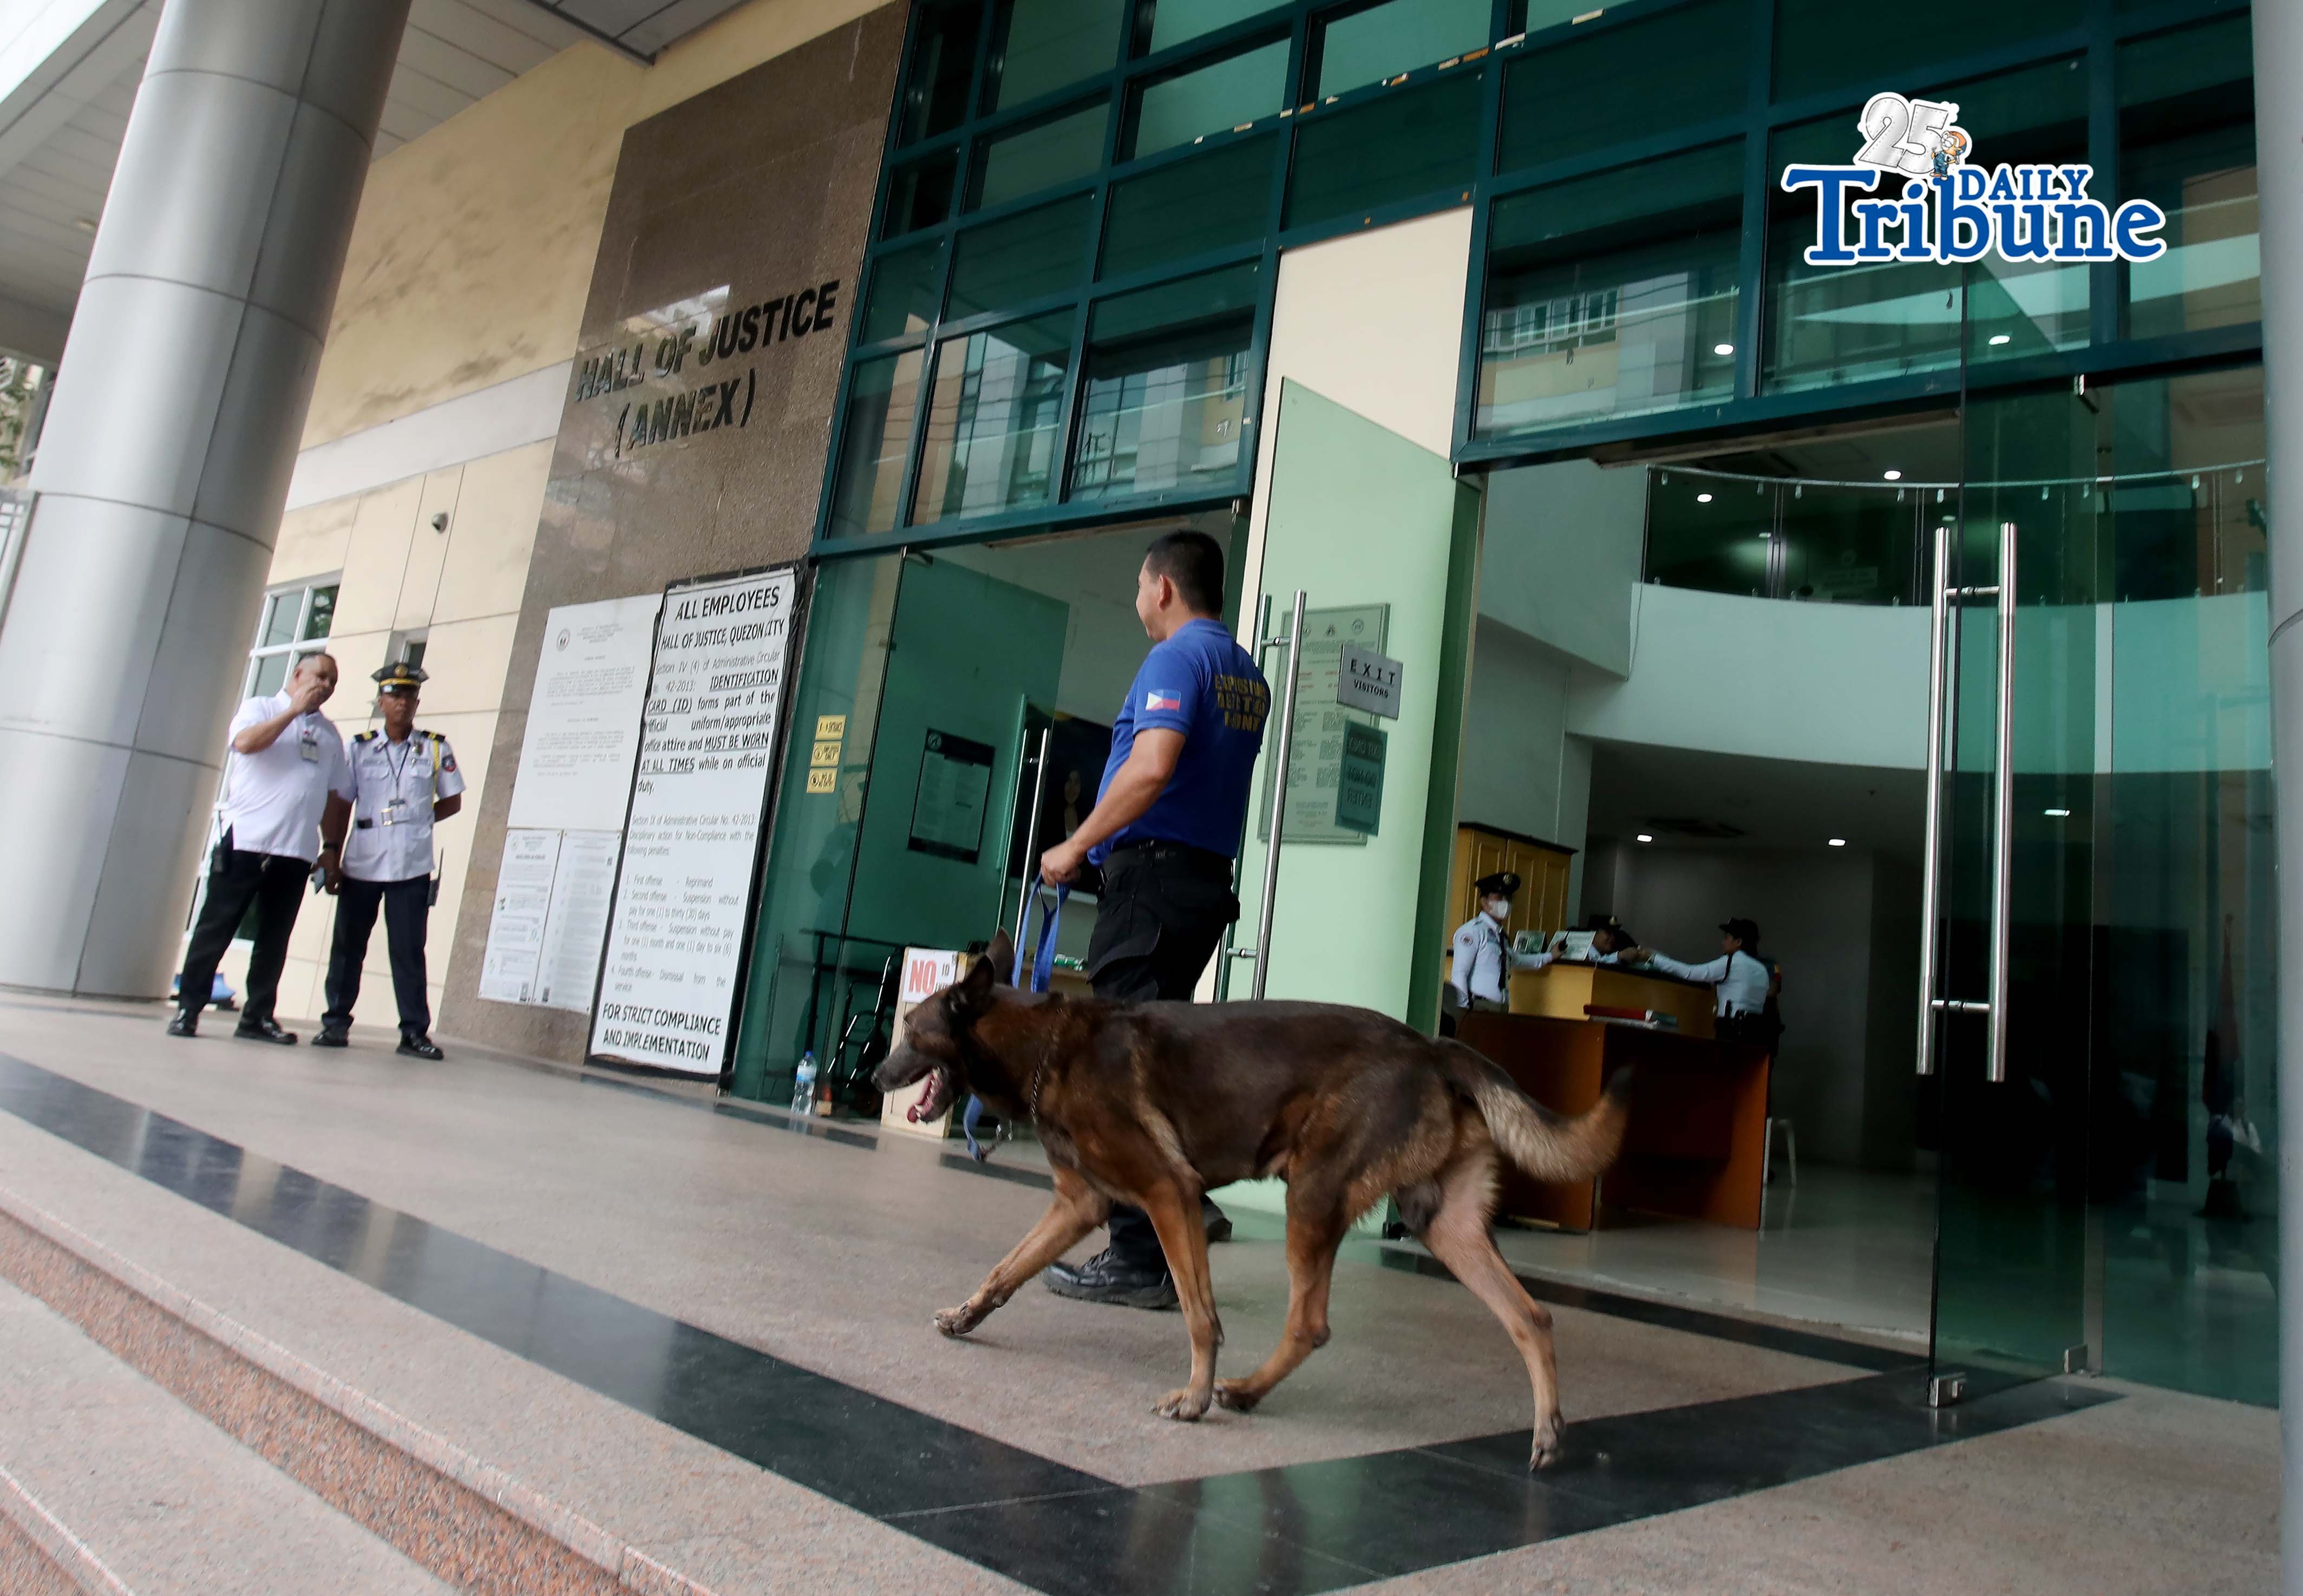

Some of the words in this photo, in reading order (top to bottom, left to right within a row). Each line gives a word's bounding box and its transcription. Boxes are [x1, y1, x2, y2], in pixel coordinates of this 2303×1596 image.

[575, 343, 645, 402] HALL
[653, 325, 696, 378] OF
[698, 279, 840, 367] JUSTICE
[613, 368, 756, 459] (ANNEX)
[675, 600, 698, 621] ALL
[702, 586, 780, 617] EMPLOYEES
[660, 633, 679, 651] HALL
[682, 632, 693, 649] OF
[693, 625, 728, 649] JUSTICE,
[730, 623, 763, 646] QUEZON
[764, 618, 786, 637] CITY
[710, 668, 779, 690] IDENTIFICATION
[1350, 659, 1396, 686] EXIT
[648, 698, 667, 712] CARD
[672, 697, 693, 714] (ID)
[697, 696, 719, 711] forms
[724, 695, 742, 711] part
[745, 689, 755, 704] of
[760, 688, 776, 703] the
[1354, 679, 1389, 699] VISITORS
[691, 711, 771, 731] uniform/appropriate
[662, 737, 686, 751] attire
[688, 737, 703, 750] and
[704, 735, 728, 750] MUST
[728, 733, 740, 748] BE
[742, 731, 769, 747] WORN
[641, 758, 650, 771] AT
[669, 757, 695, 772] TIMES
[699, 756, 719, 770] while
[723, 757, 733, 769] on
[737, 753, 767, 769] official
[908, 959, 937, 995] NO
[602, 1002, 621, 1021] FOR
[623, 1004, 655, 1025] STRICT
[654, 1009, 722, 1036] COMPLIANCE
[603, 1028, 622, 1046] AND
[623, 1030, 711, 1062] IMPLEMENTATION
